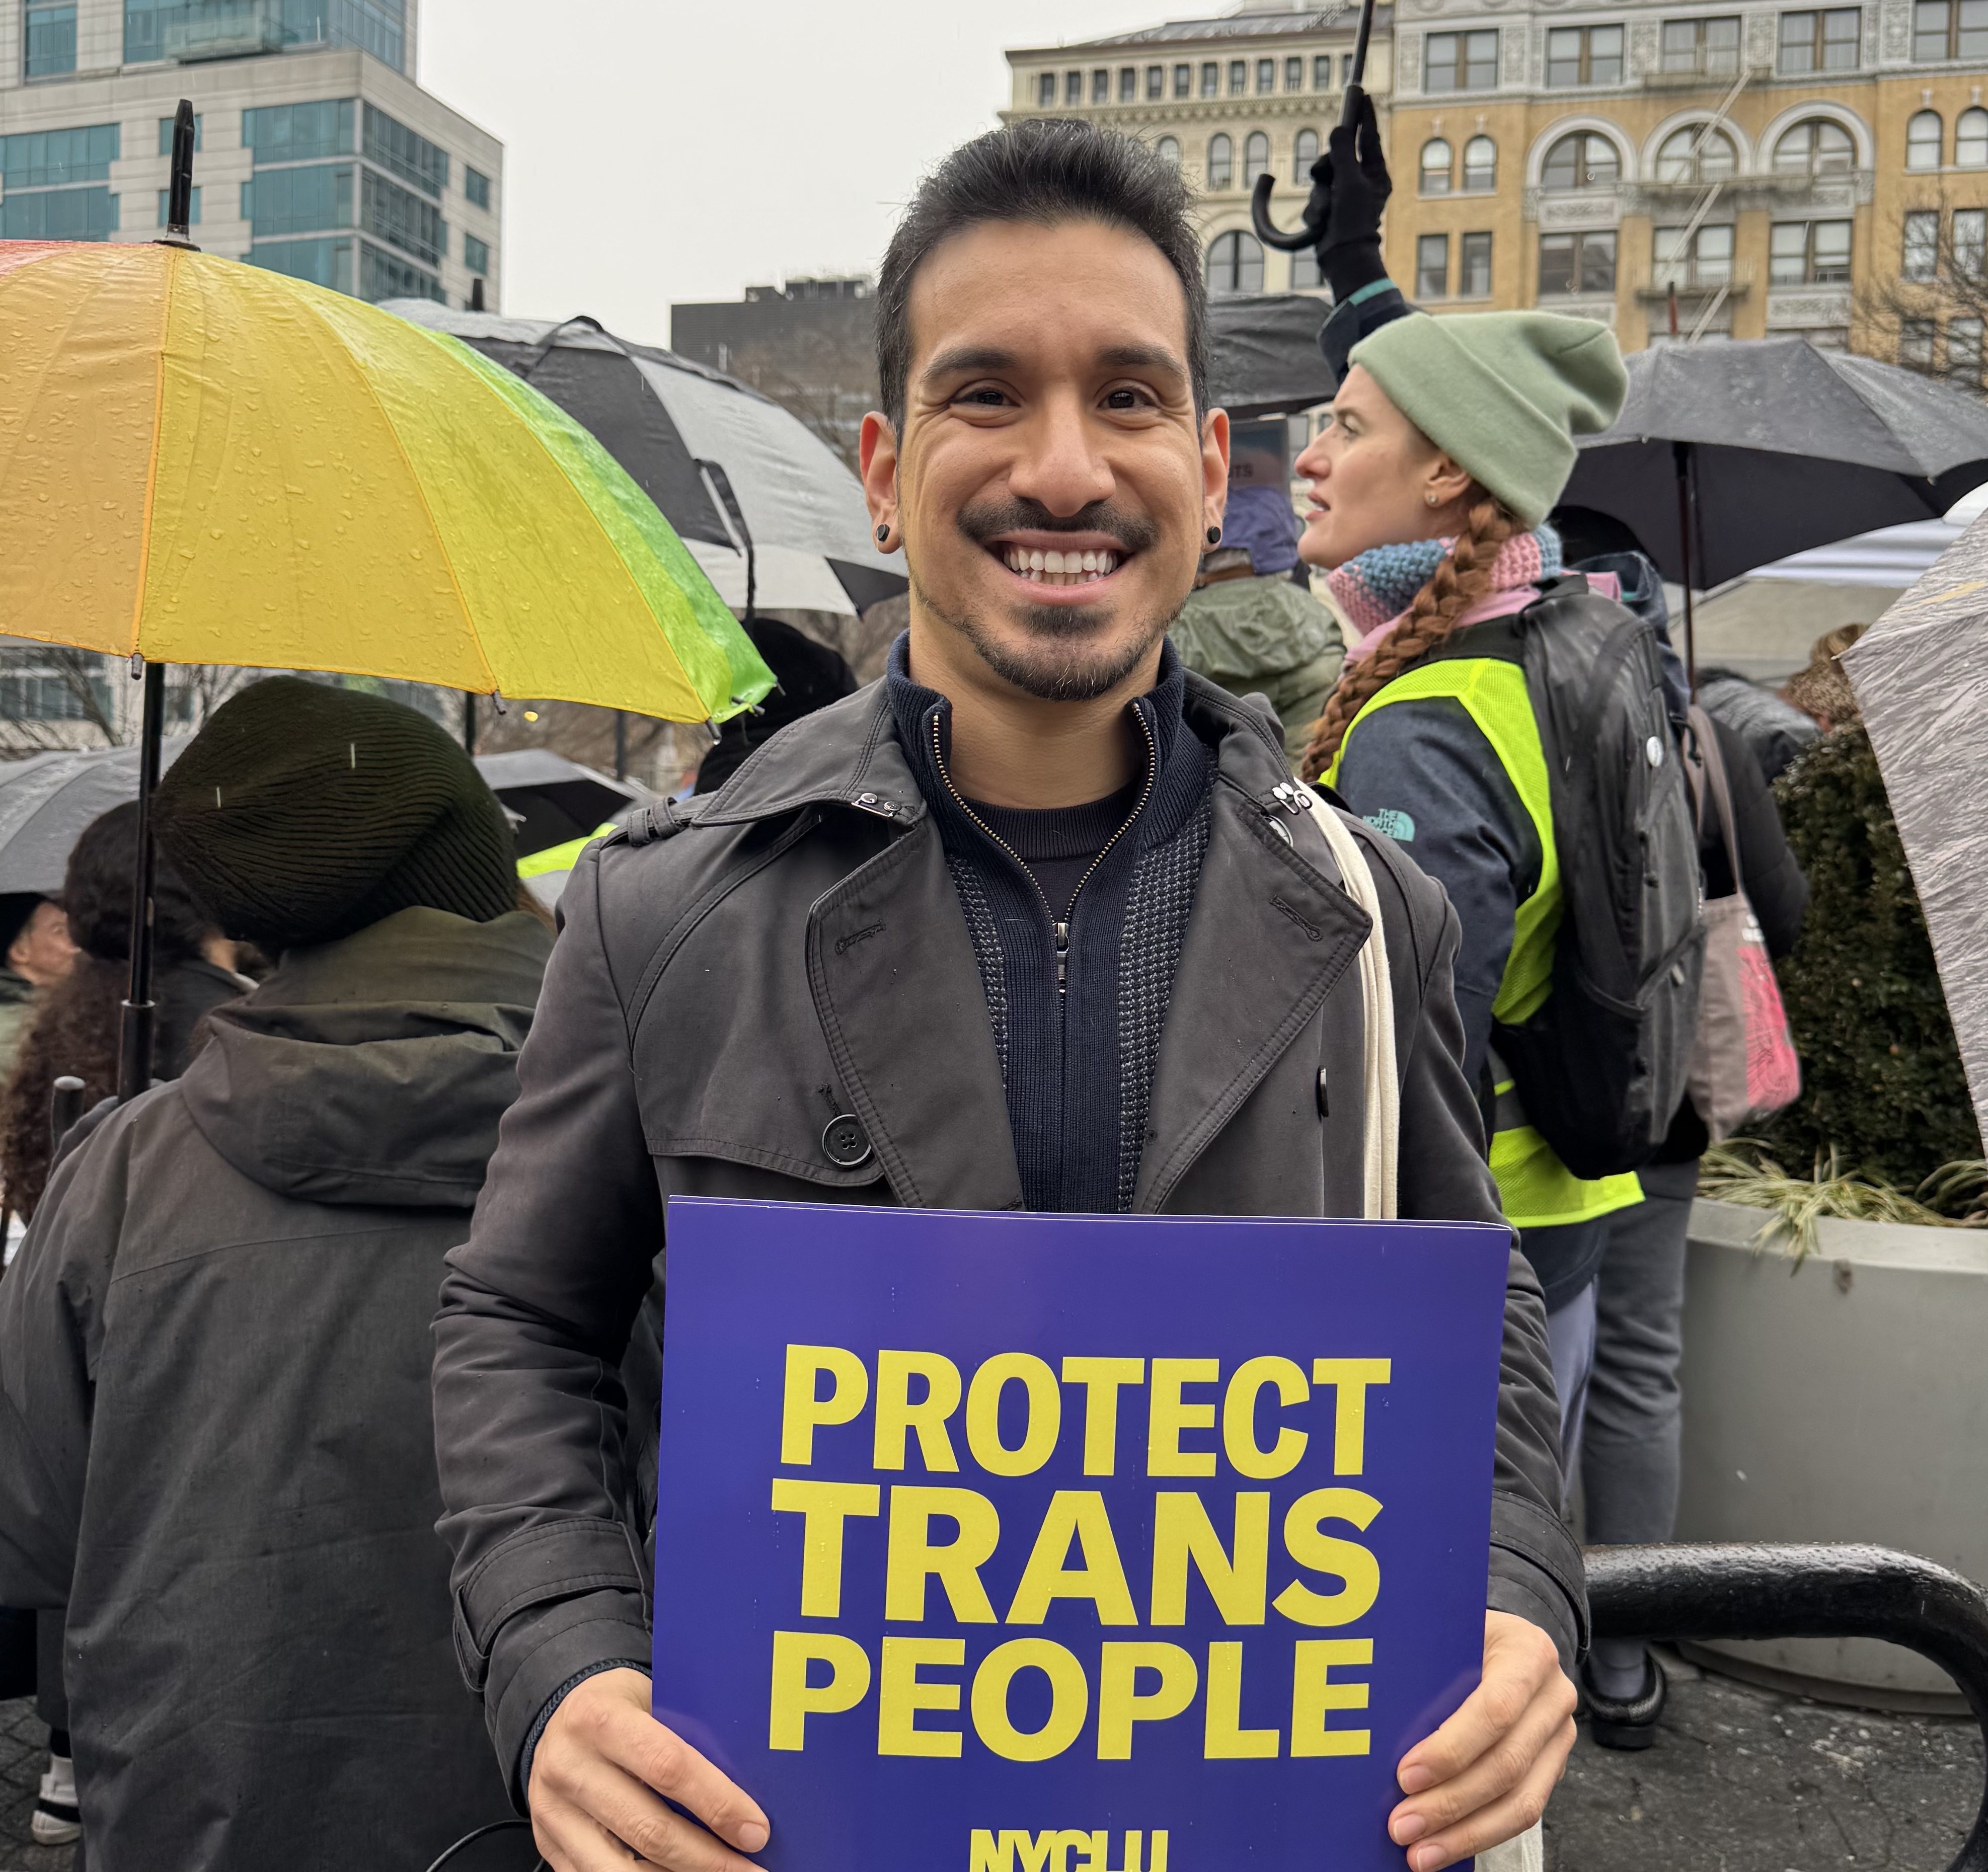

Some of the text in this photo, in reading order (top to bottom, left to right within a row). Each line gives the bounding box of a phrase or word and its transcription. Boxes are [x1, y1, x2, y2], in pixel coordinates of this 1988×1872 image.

[1378, 808, 1398, 820] THE
[781, 1344, 1391, 1479] PROTECT
[771, 1478, 1383, 1626] TRANS
[769, 1630, 1374, 1762] PEOPLE
[969, 1829, 1169, 1872] NYCLU
